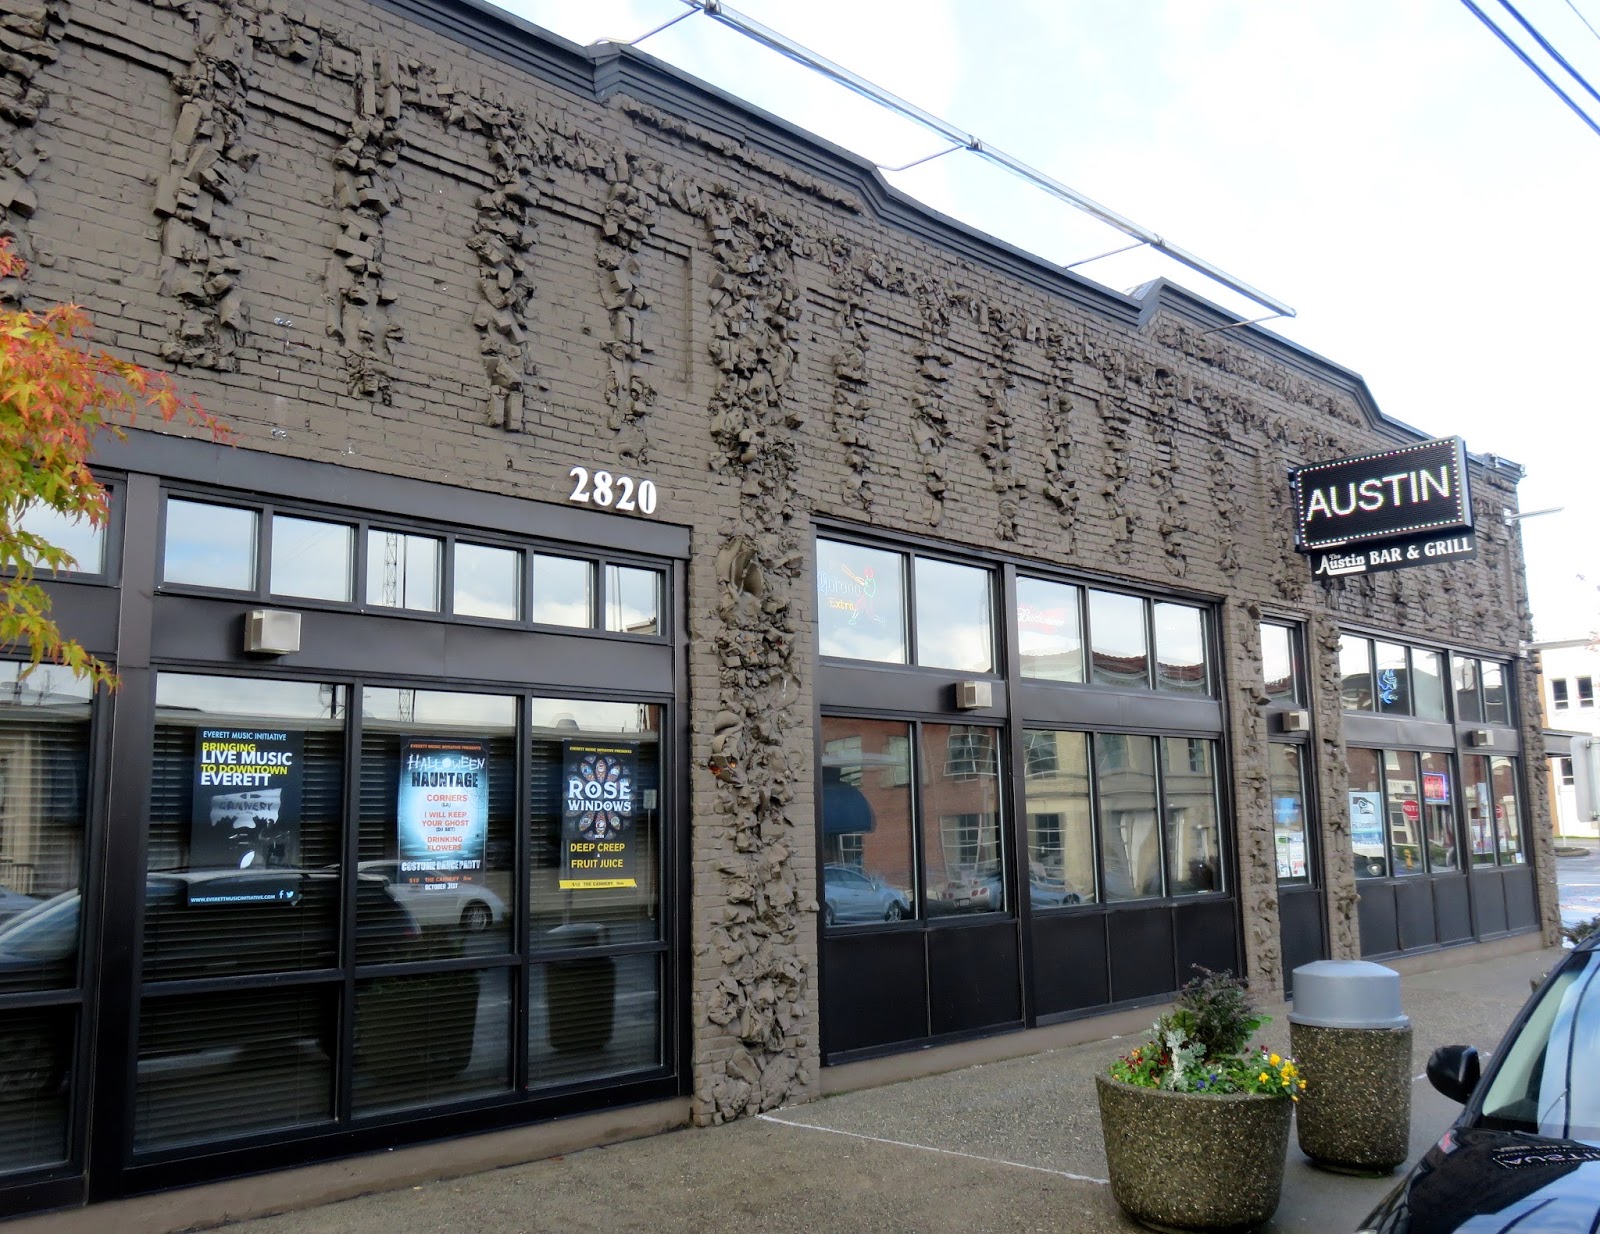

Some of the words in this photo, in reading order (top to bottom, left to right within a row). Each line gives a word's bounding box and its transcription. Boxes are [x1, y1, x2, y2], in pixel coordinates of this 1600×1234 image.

[569, 466, 657, 515] 2820
[1306, 465, 1450, 521] AUSTIN
[1315, 553, 1366, 576] Austin
[1369, 548, 1402, 565] BAR
[1406, 545, 1420, 559] &
[1424, 537, 1473, 557] GRILL
[828, 597, 855, 611] Extra
[203, 731, 230, 739] EVERETT
[231, 732, 253, 740] MUSIC
[254, 733, 287, 741] INITIATIVE
[202, 742, 256, 752] BRINGING
[202, 750, 237, 764] LIVE
[241, 752, 293, 765] MUSIC
[407, 753, 485, 771] HALLOWEEN
[201, 764, 216, 773] TO
[219, 765, 287, 774] DOWNTOWN
[201, 772, 271, 786] EVERETT
[412, 771, 479, 788] HAUNTAGE
[568, 780, 631, 799] ROSE
[426, 794, 468, 802] CORNERS
[568, 800, 632, 811] WINDOWS
[570, 843, 595, 852] DEEP
[597, 843, 625, 852] CREEP
[401, 861, 436, 872] COSTUME
[571, 859, 598, 868] FRUIT
[600, 859, 623, 868] JUICE
